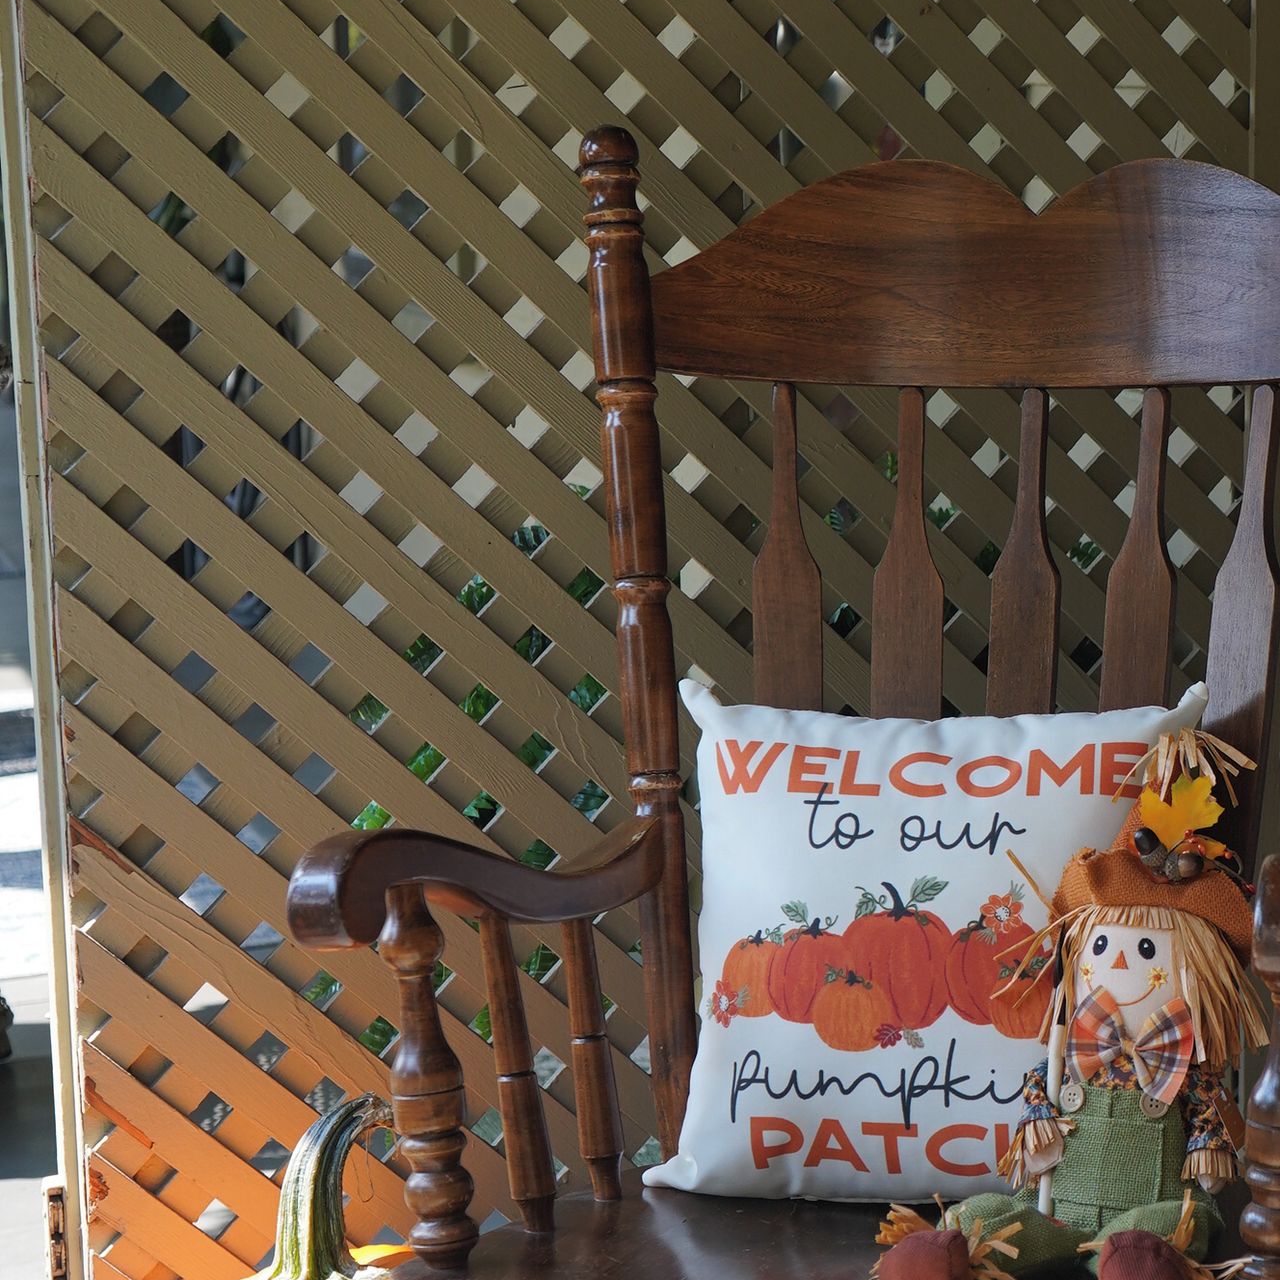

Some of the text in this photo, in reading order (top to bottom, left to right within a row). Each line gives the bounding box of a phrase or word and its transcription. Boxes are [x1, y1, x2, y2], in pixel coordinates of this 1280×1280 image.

[715, 738, 1150, 799] WELCOME
[803, 782, 1027, 856] to our
[730, 1038, 1027, 1131] pumpki
